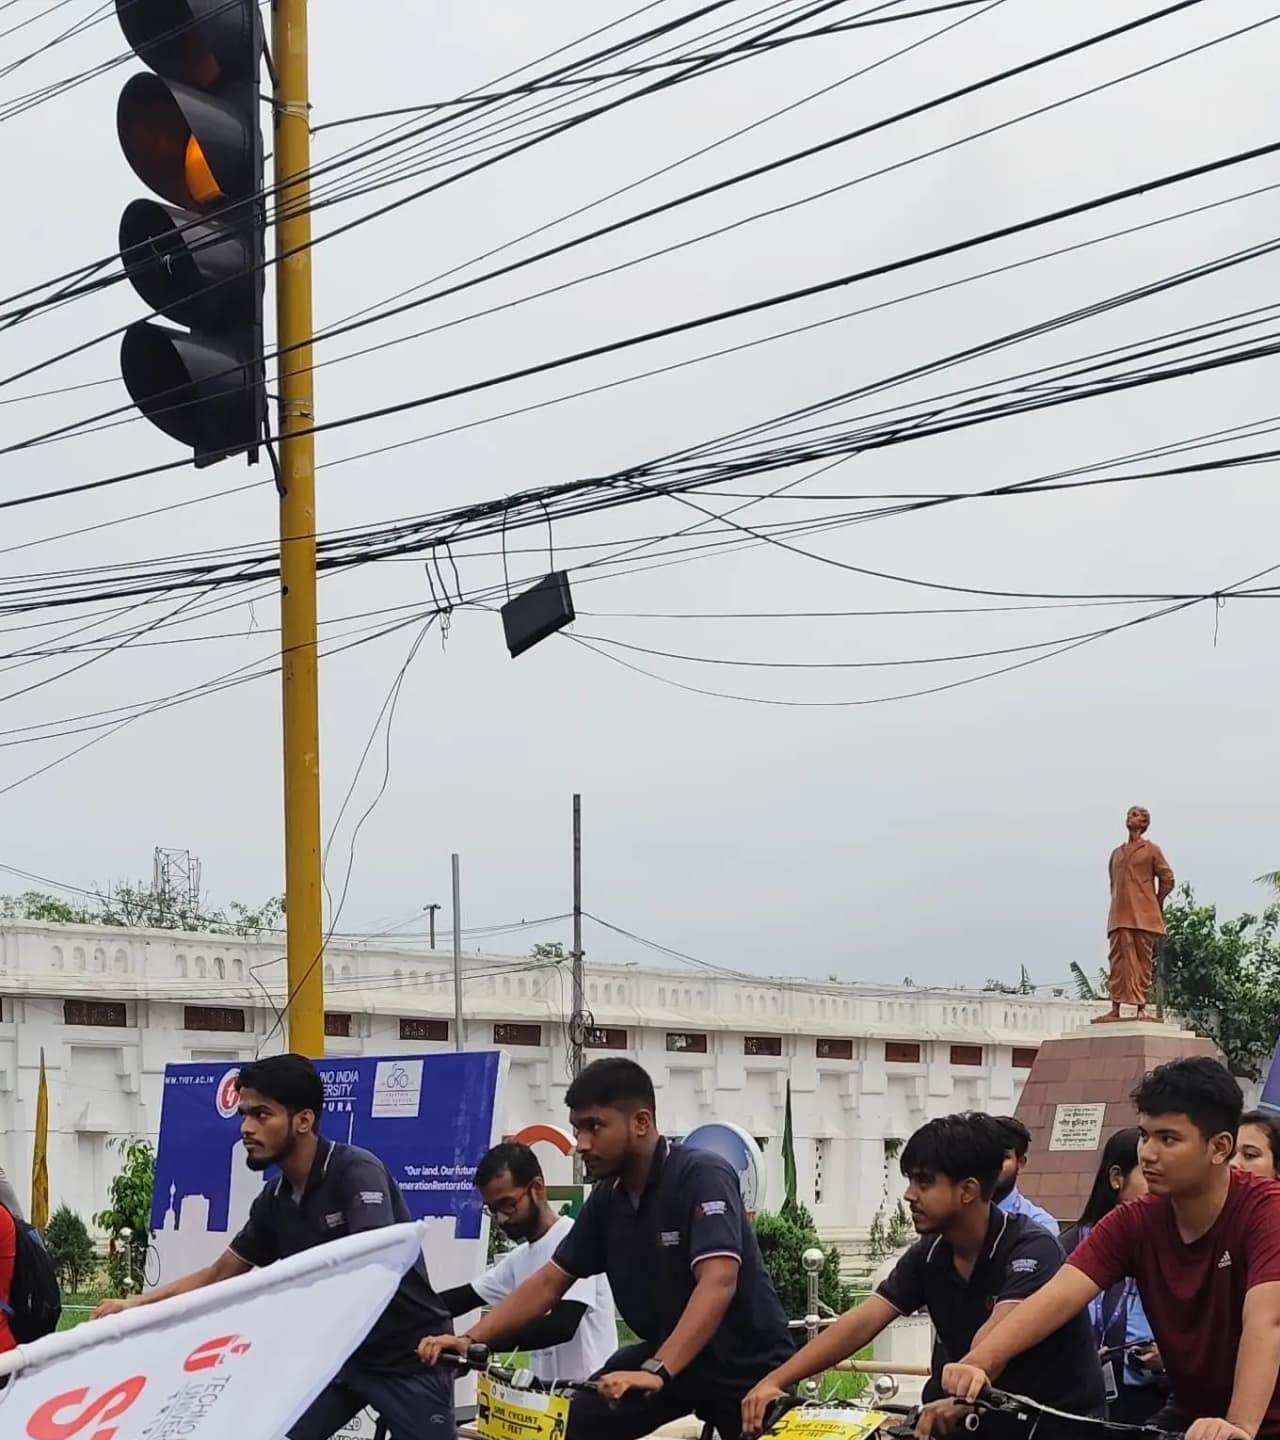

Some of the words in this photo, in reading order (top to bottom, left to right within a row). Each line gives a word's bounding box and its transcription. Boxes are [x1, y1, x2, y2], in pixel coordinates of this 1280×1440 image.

[334, 1070, 359, 1083] INDIA
[323, 1084, 352, 1097] ERSITY
[455, 1165, 477, 1175] futur
